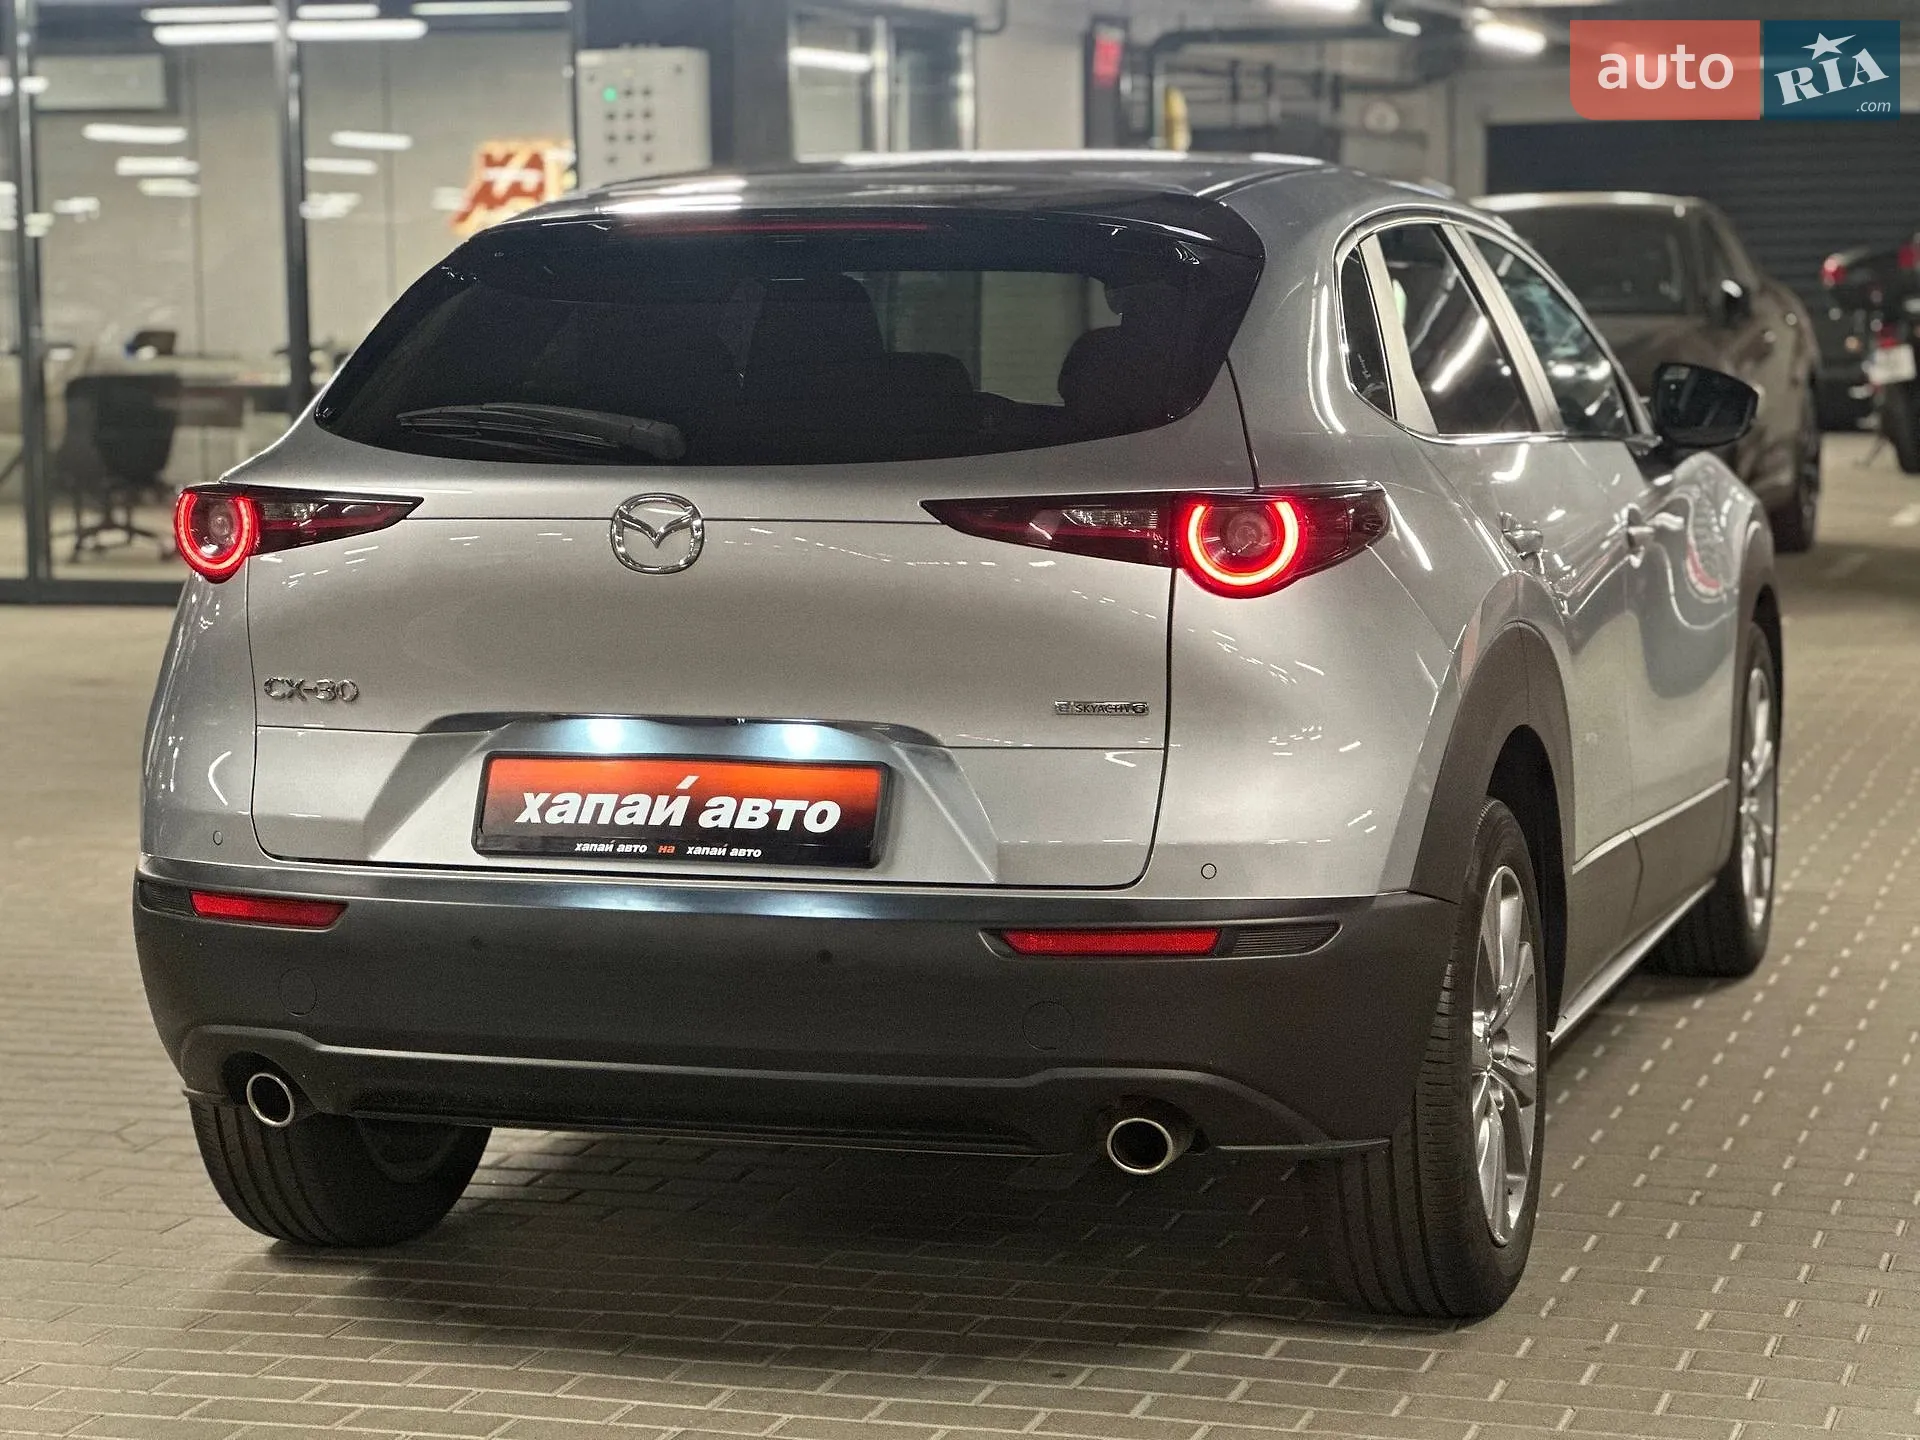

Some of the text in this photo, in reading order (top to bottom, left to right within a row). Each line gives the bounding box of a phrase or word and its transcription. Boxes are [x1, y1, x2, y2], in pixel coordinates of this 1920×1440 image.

[263, 676, 359, 702] CX-30
[698, 795, 841, 833] авто
[616, 843, 648, 853] авто
[657, 845, 676, 854] на
[729, 847, 762, 858] авто
